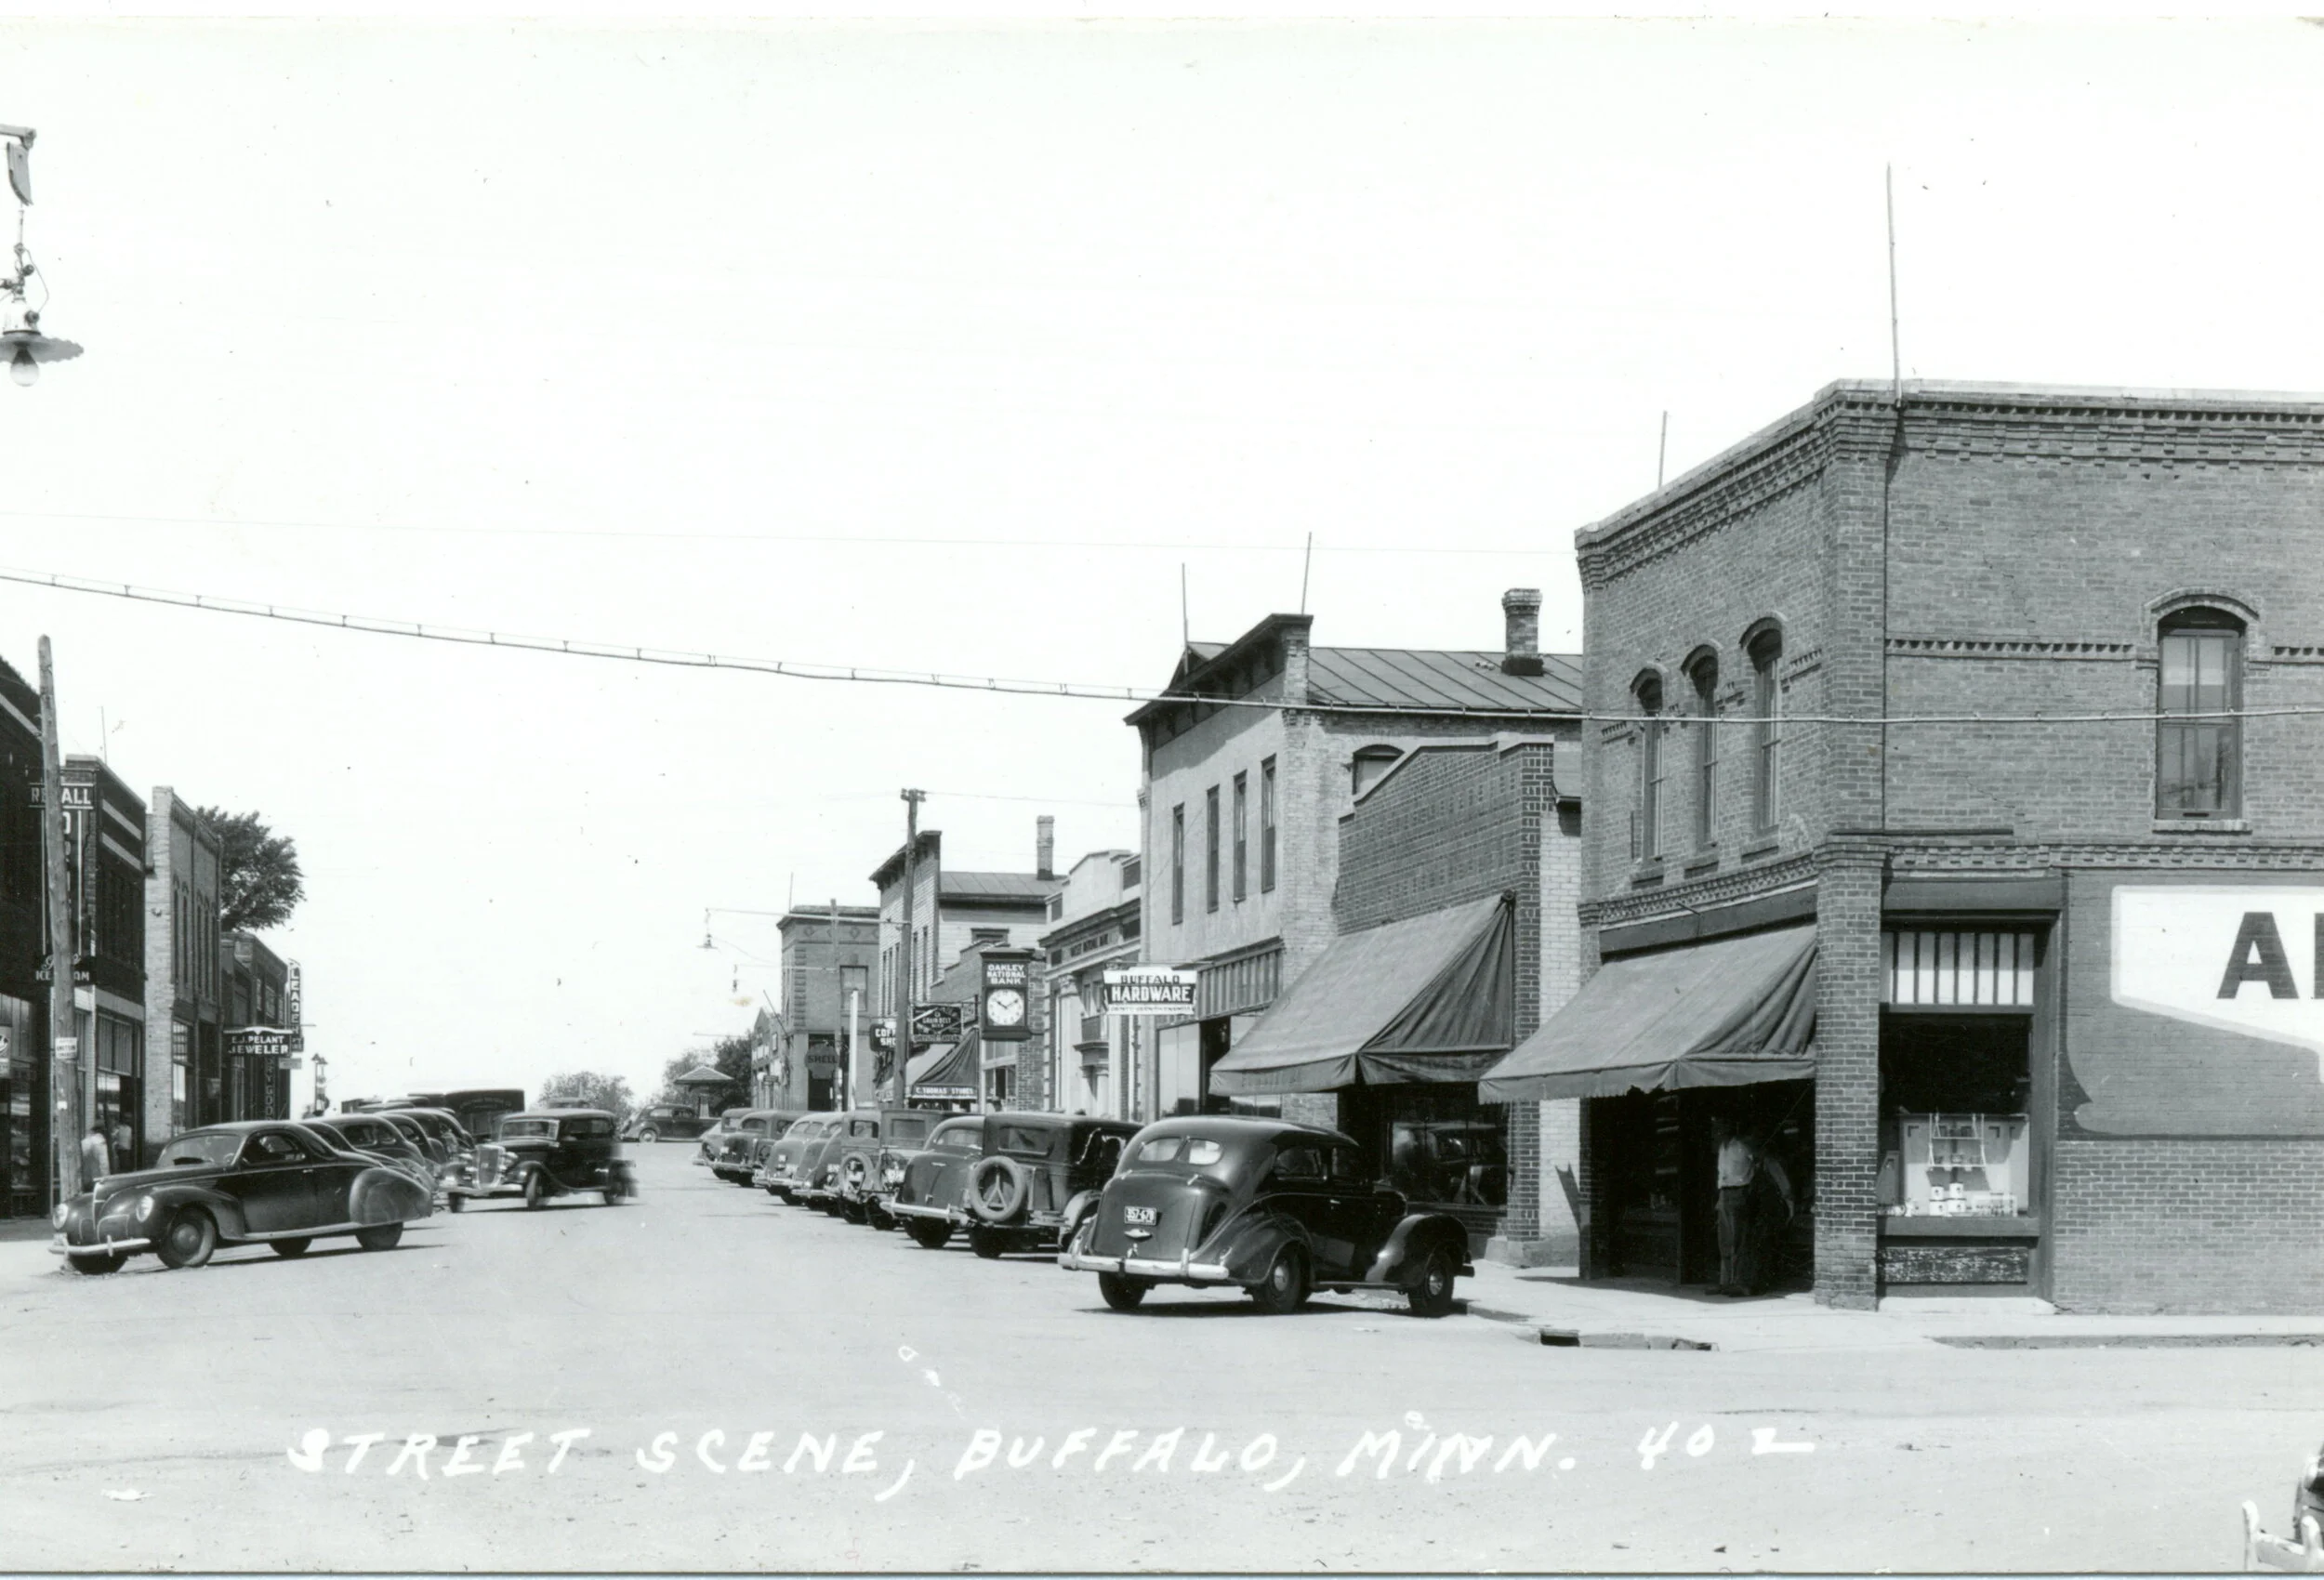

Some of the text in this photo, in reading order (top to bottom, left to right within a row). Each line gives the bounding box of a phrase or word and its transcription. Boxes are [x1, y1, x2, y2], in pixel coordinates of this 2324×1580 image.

[2216, 912, 2324, 999] A
[1120, 975, 1180, 984] BUFFALO
[1111, 986, 1191, 1002] HARDWARE
[228, 1045, 289, 1054] JEWELER
[807, 1055, 838, 1064] SHELL
